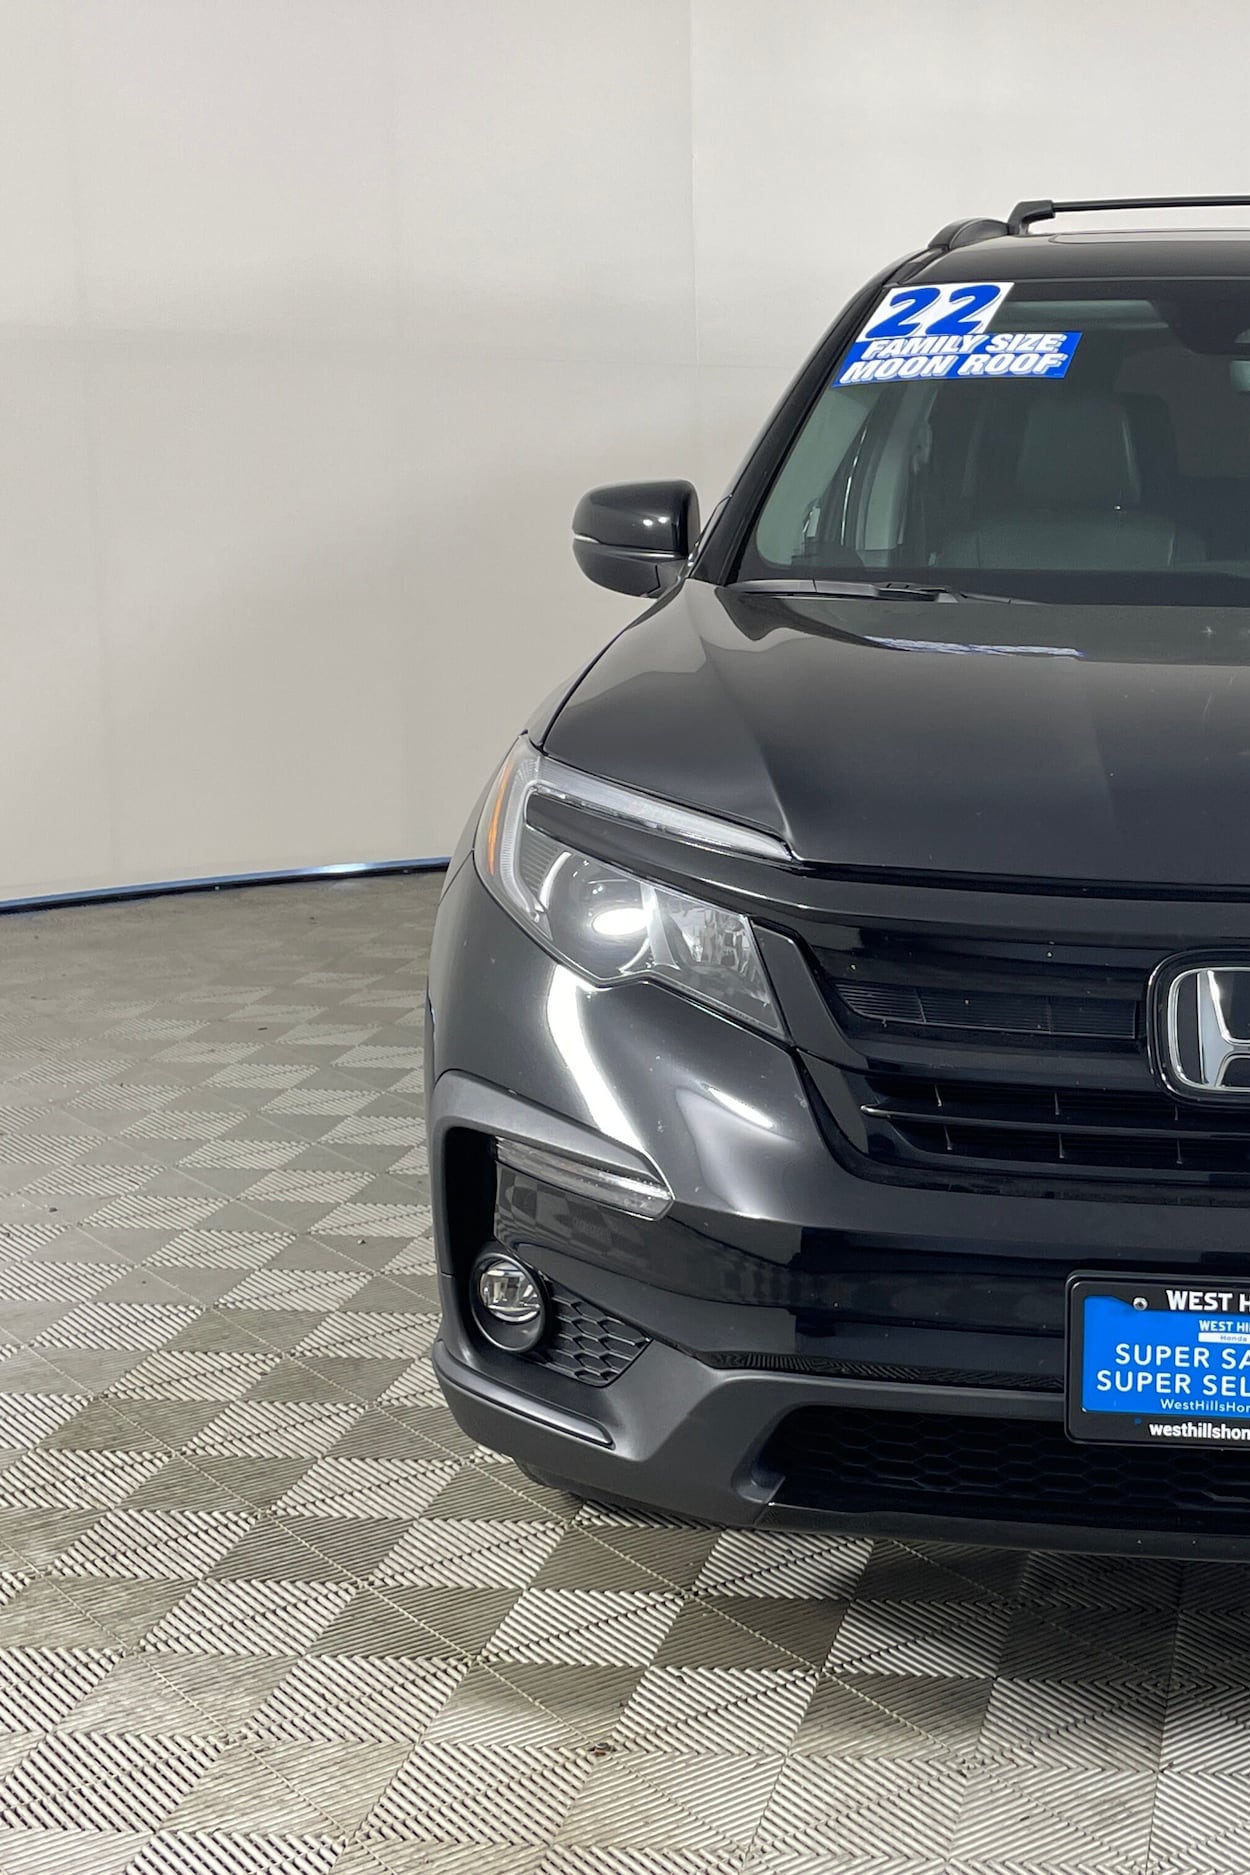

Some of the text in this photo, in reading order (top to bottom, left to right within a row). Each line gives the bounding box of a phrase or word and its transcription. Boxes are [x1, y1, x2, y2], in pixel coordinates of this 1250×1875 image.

[864, 284, 1002, 338] 22
[861, 333, 1068, 360] FAMILY SIZE
[839, 353, 1068, 384] MOON ROOF
[1165, 1289, 1233, 1311] WEST
[1199, 1320, 1233, 1332] WEST
[1115, 1343, 1210, 1369] SUPER
[1096, 1370, 1192, 1395] SUPER
